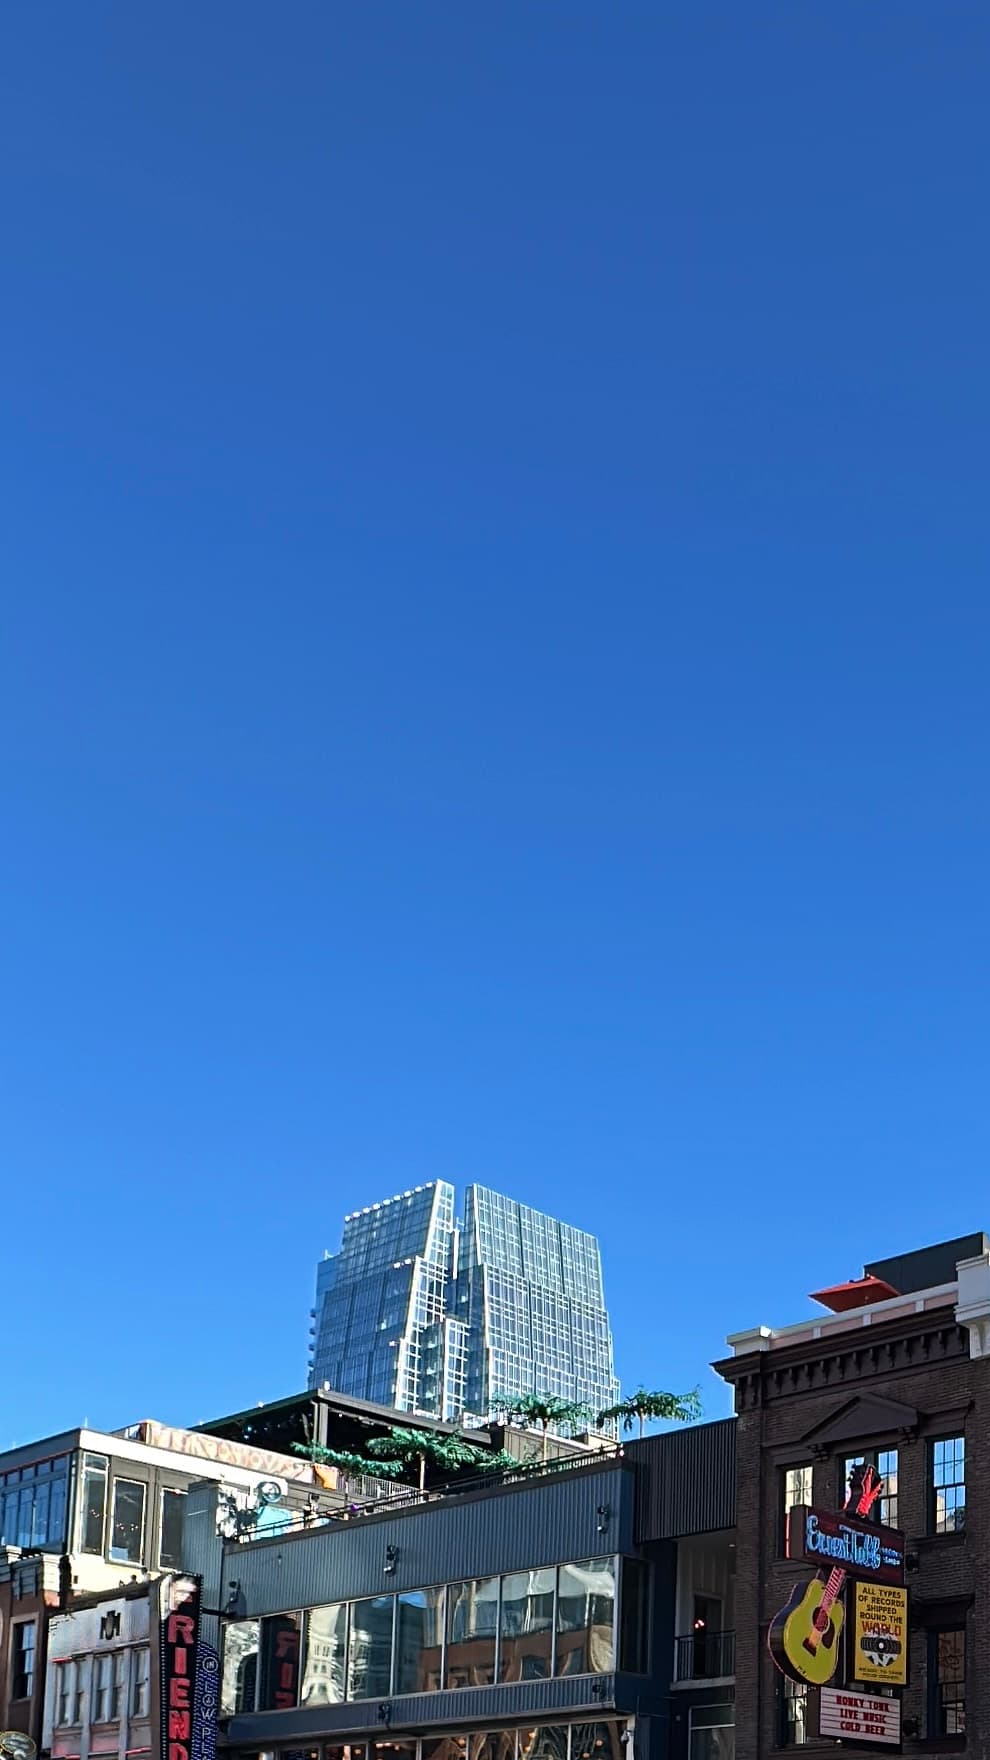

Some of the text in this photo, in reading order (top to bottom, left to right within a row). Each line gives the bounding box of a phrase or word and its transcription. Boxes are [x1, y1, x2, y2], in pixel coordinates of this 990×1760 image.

[858, 1594, 905, 1608] OF RECORDS
[862, 1587, 902, 1600] ALL TYPES
[866, 1604, 897, 1615] SHIPPED
[860, 1612, 903, 1624] ROUND THE
[861, 1620, 901, 1637] WORLD
[201, 1682, 214, 1720] LOW
[836, 1695, 890, 1713] HONKY TONK
[839, 1708, 888, 1724] LIVE MUSIC
[839, 1721, 886, 1736] COLD BEER
